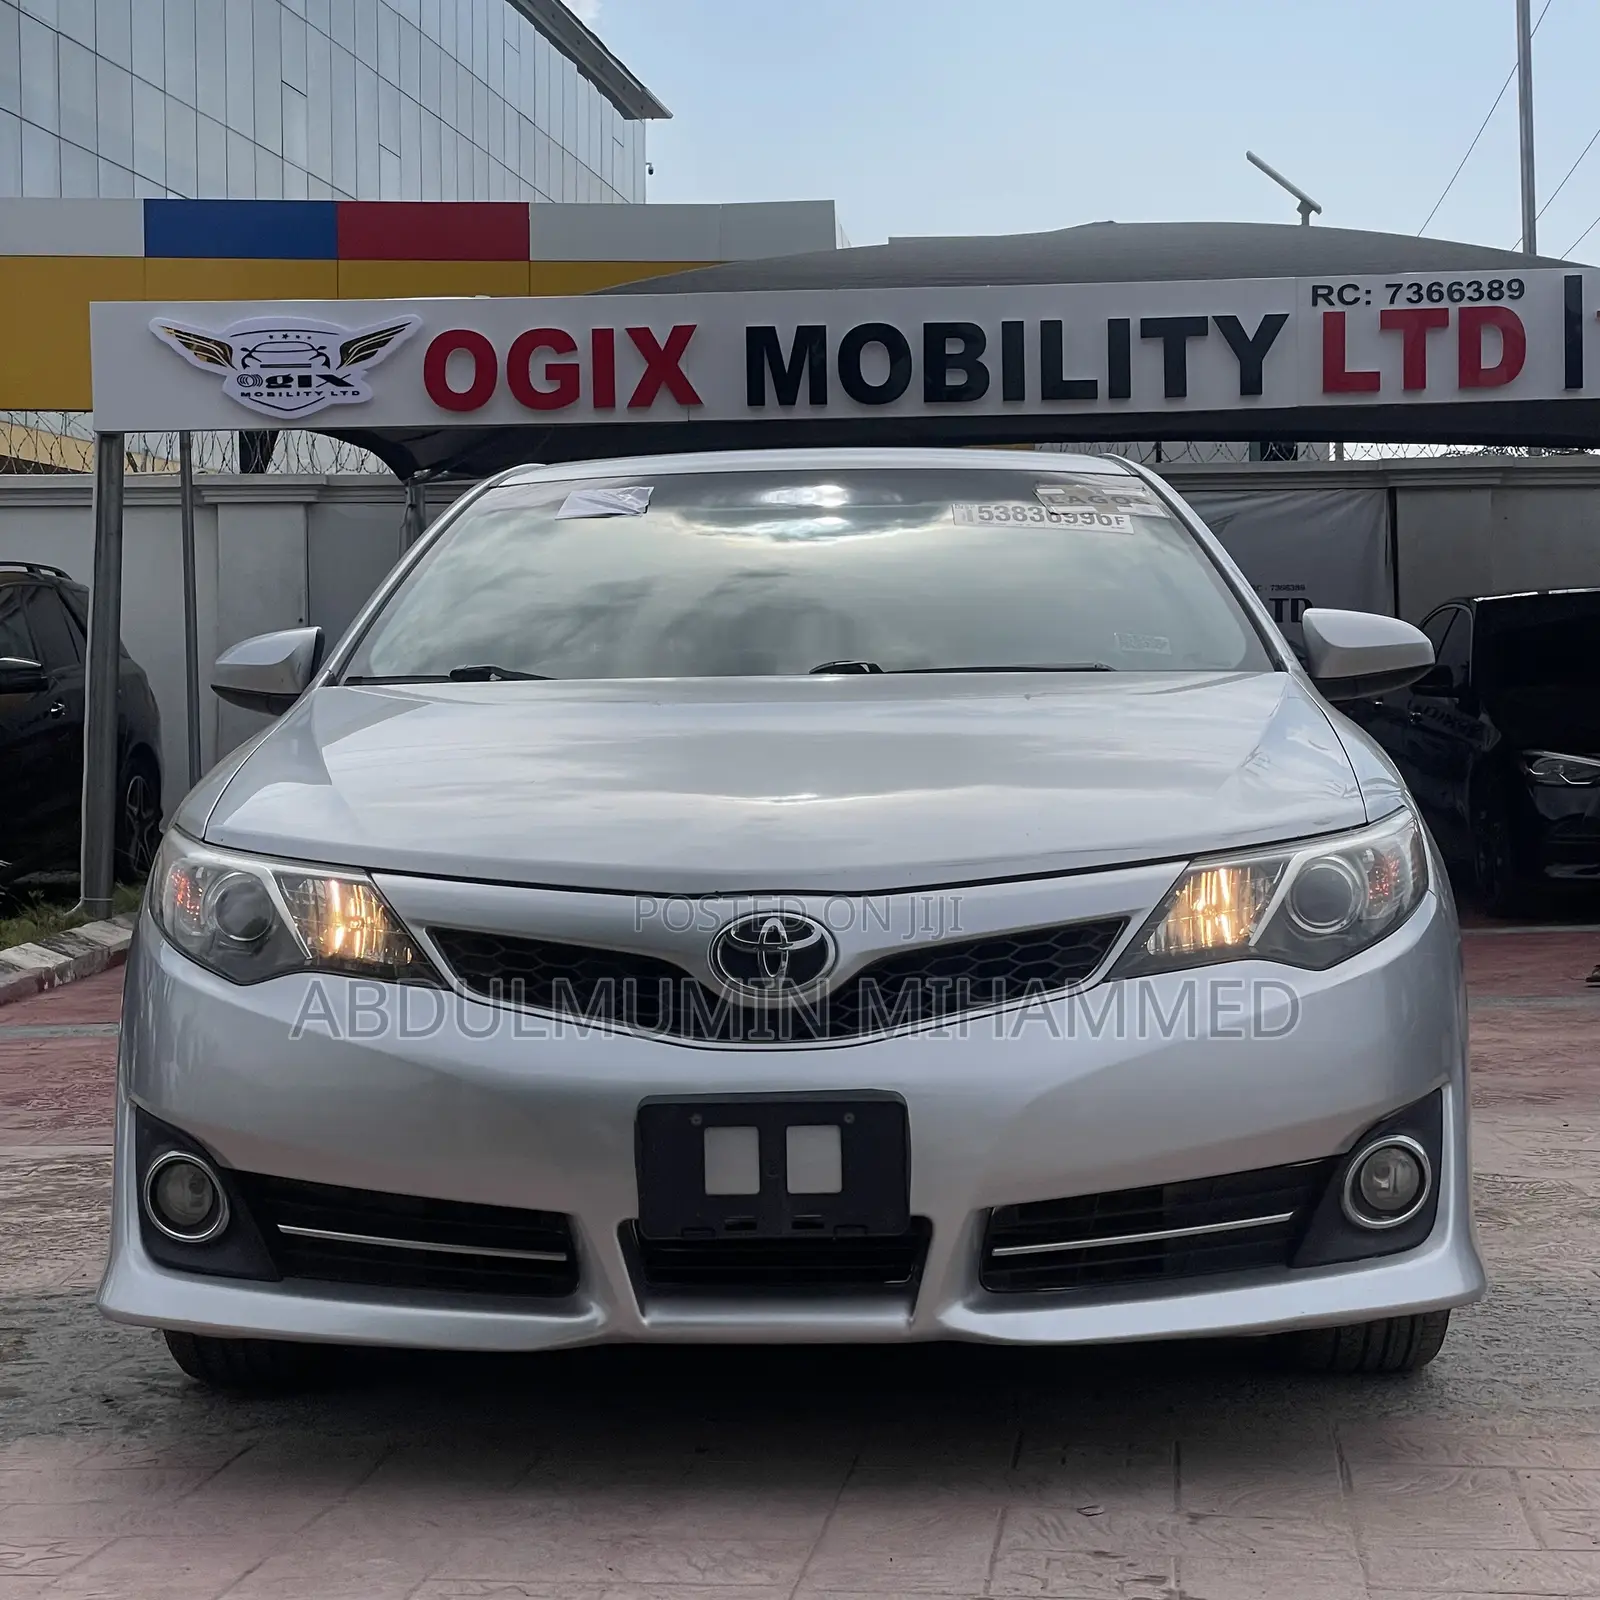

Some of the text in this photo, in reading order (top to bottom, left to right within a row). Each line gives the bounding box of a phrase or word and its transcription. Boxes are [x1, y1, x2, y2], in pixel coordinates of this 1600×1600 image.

[1311, 278, 1525, 307] RC: 7366389
[423, 305, 1526, 412] OGIX MOBILITY LTD
[1269, 597, 1313, 623] TD
